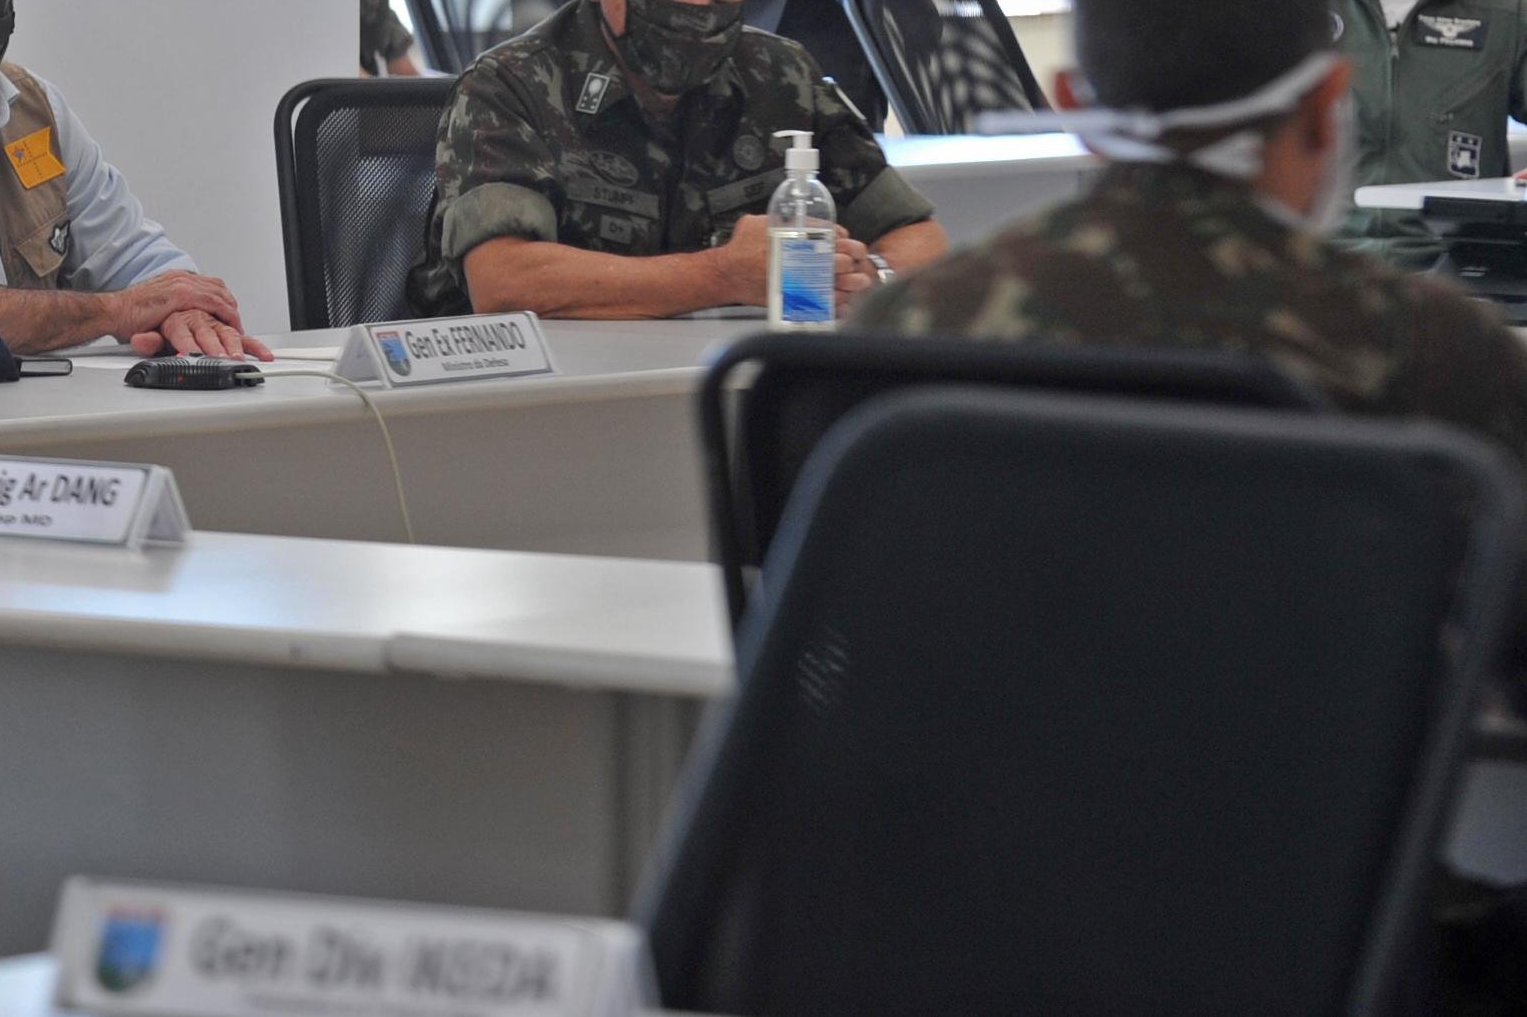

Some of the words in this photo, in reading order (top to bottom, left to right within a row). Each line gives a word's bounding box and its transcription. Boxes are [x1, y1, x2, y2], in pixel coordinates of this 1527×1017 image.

[405, 330, 438, 359] Gen
[432, 328, 457, 357] Ex
[449, 322, 526, 355] FERNANDO
[18, 472, 48, 501] Ar
[50, 474, 123, 507] DANG
